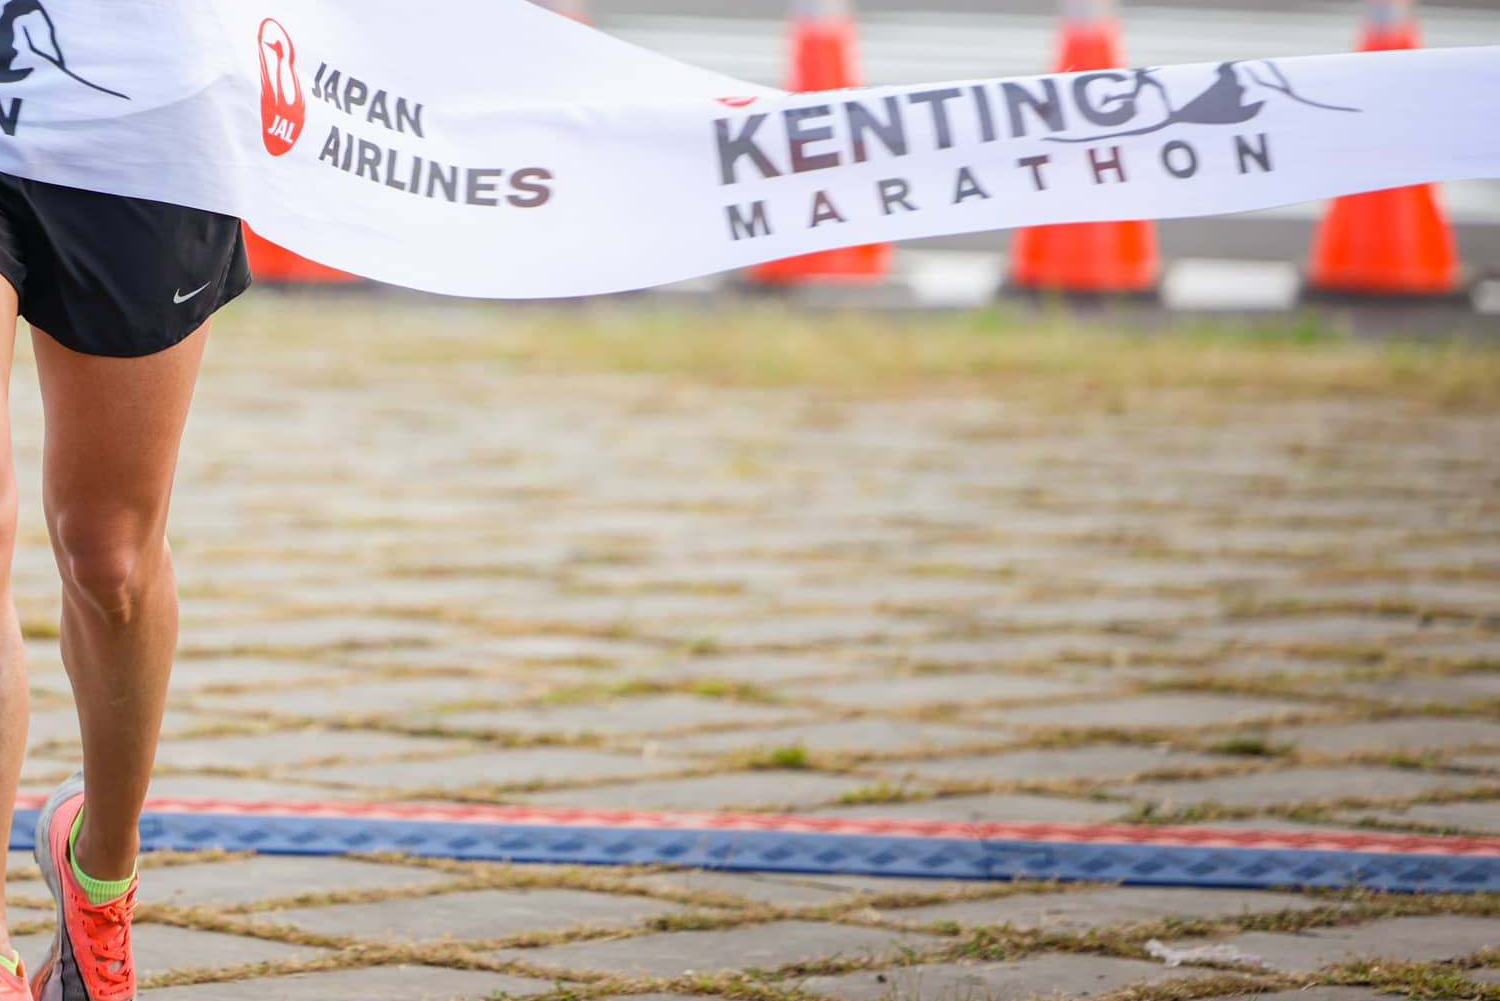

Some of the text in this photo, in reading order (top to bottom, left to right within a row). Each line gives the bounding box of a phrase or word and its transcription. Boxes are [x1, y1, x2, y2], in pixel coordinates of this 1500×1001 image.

[267, 115, 296, 143] JAL
[312, 62, 425, 139] JAPAN
[713, 72, 1138, 185] KENTING
[319, 125, 554, 208] AIRLINES
[725, 133, 1274, 241] MARATHON
